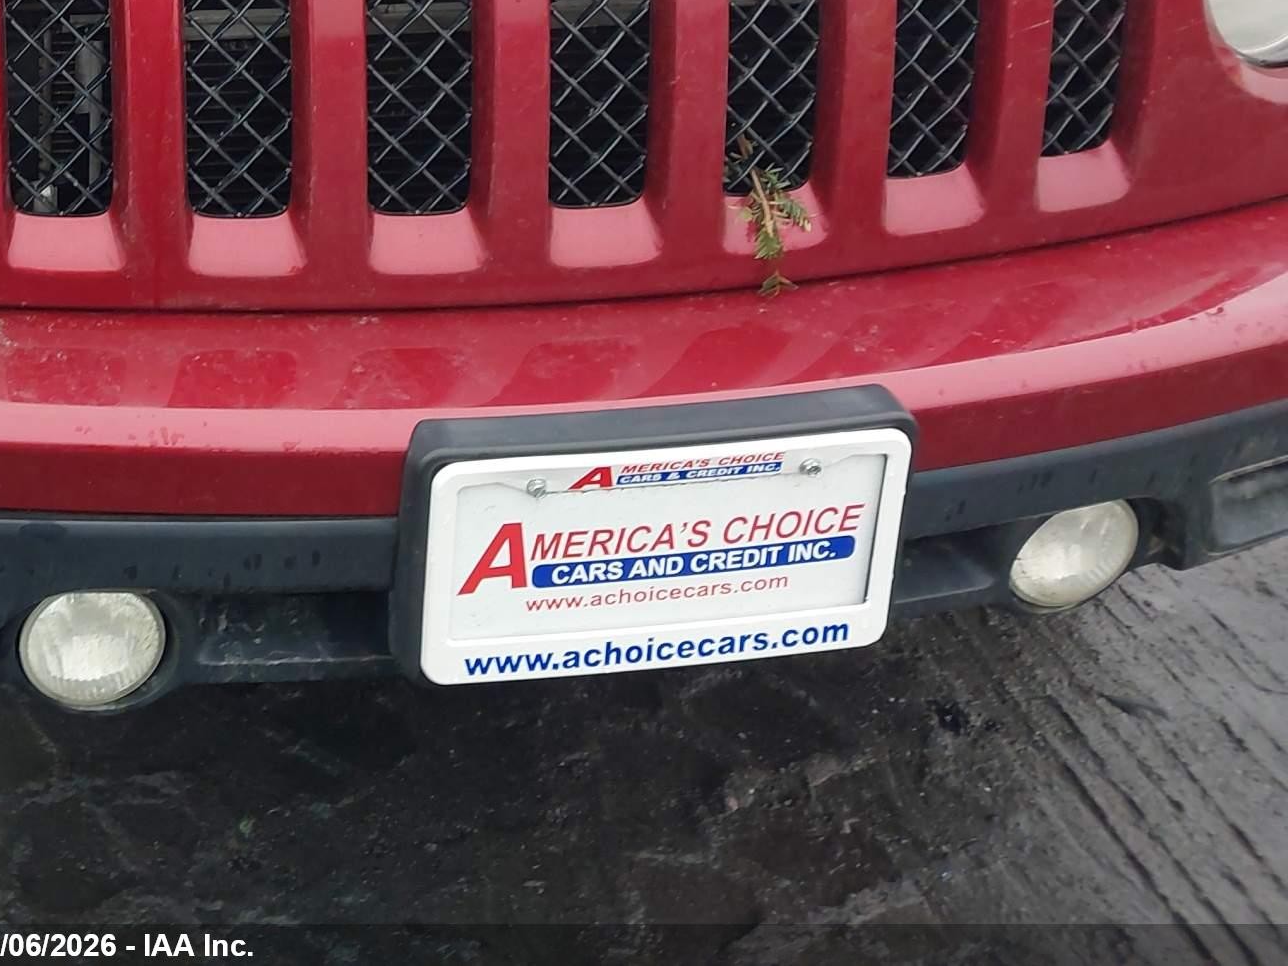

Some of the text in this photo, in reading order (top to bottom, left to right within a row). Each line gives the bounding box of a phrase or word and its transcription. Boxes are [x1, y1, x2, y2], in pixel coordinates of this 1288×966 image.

[568, 452, 786, 490] AMERICA'S CHOICE
[619, 462, 782, 485] CARS & CREDIT INC.
[457, 504, 865, 596] AMERICA'S CHOICE
[550, 540, 836, 585] CARS AND CREDIT INC.
[526, 574, 789, 612] www.achoicecars.com
[464, 622, 850, 677] www.achoicecars.com
